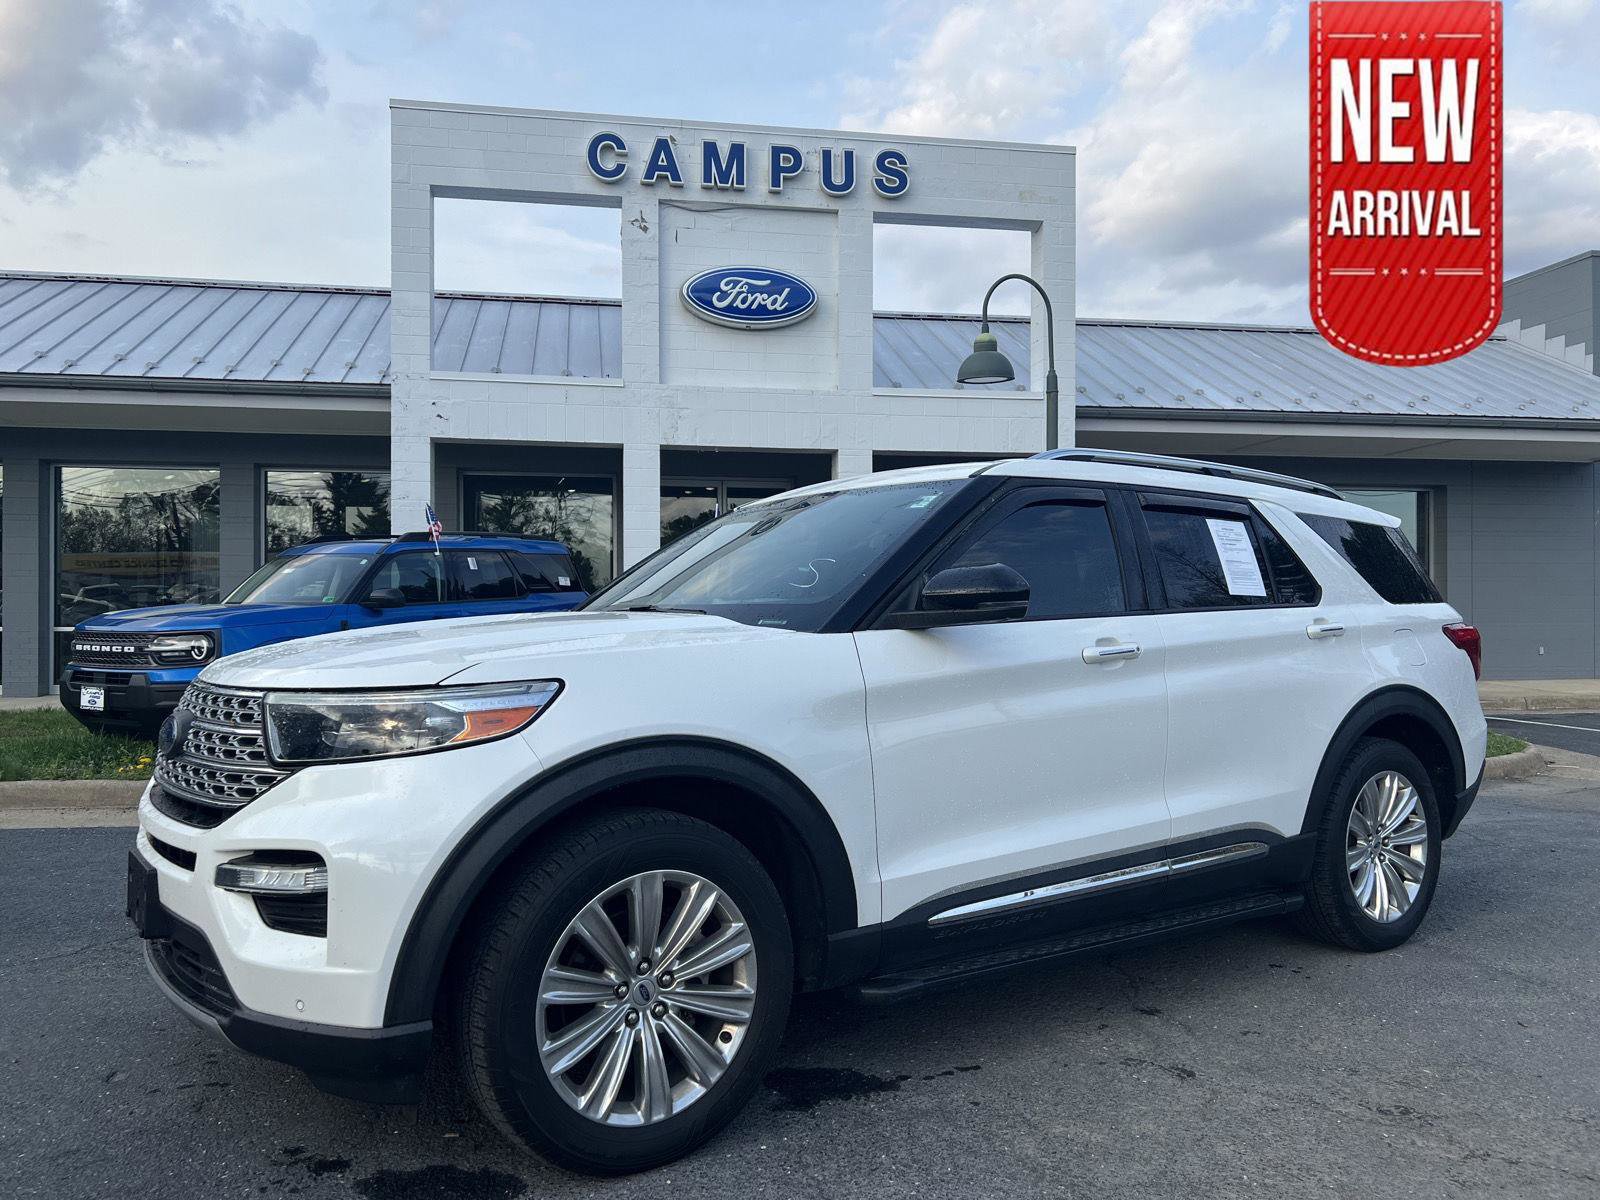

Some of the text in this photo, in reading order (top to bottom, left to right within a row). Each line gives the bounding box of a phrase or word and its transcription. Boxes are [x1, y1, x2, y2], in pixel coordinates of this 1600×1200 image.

[586, 130, 910, 199] CAMPUS
[711, 276, 791, 311] Ford
[75, 644, 135, 653] BRONCO
